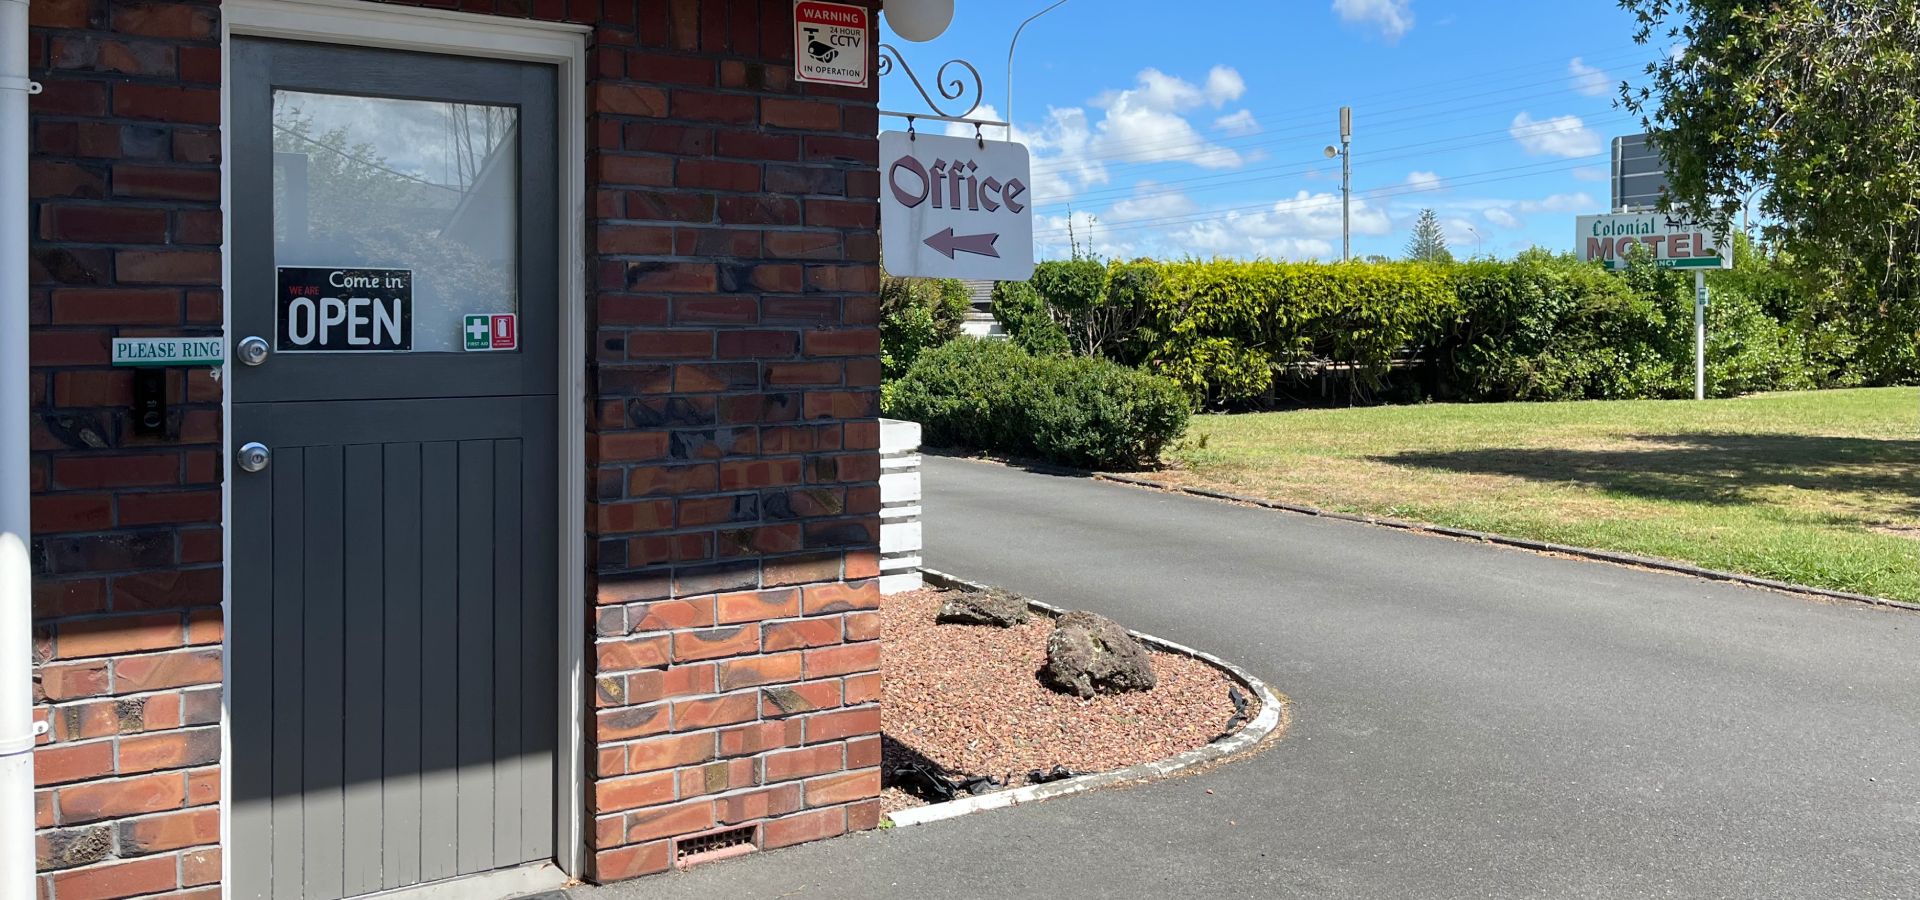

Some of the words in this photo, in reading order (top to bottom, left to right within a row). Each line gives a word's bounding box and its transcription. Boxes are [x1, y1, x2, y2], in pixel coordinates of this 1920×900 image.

[803, 8, 859, 23] WARNING
[829, 26, 838, 34] 24
[839, 28, 861, 36] HOUR
[830, 34, 861, 48] CCTV
[804, 65, 813, 73] IN
[815, 66, 860, 77] OPERATION
[888, 154, 1026, 214] Office
[1592, 217, 1655, 237] Colonial
[1586, 232, 1716, 262] MOTEL
[329, 271, 380, 288] Come
[385, 272, 404, 288] in
[289, 286, 303, 295] WE
[304, 286, 320, 295] ARE
[288, 297, 402, 346] OPEN
[117, 343, 177, 358] PLEASE
[181, 341, 220, 356] RING
